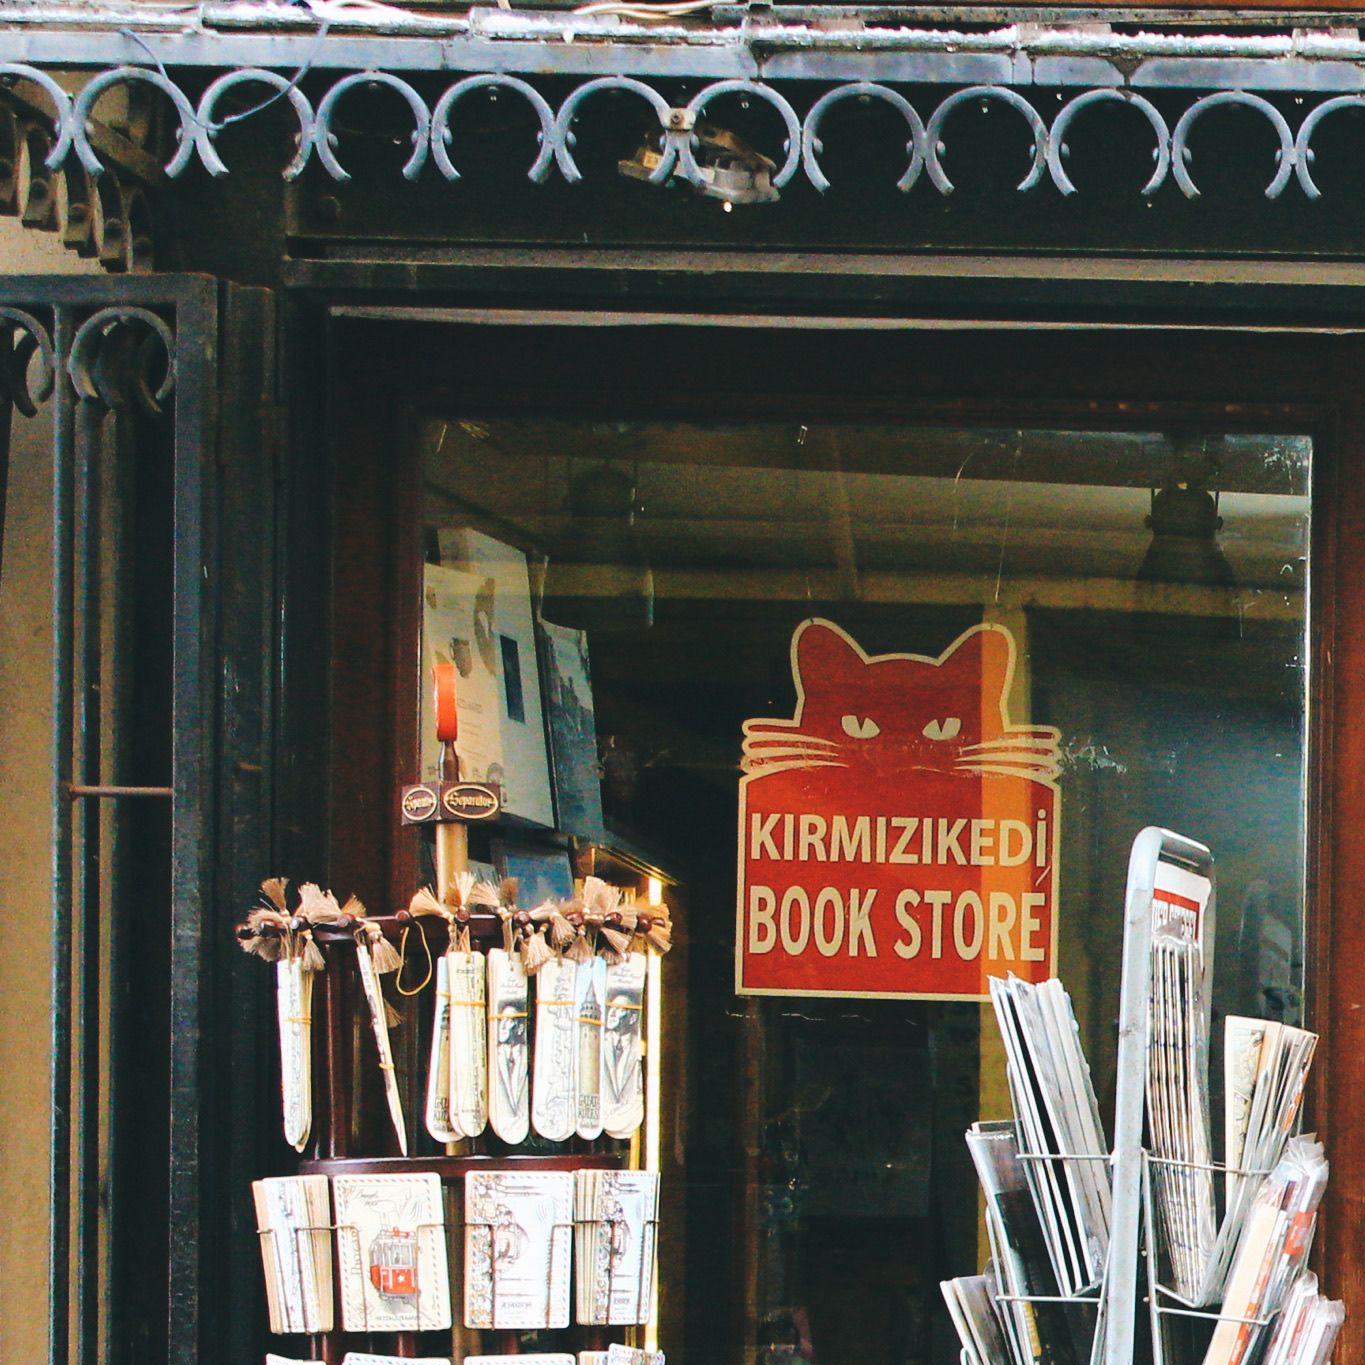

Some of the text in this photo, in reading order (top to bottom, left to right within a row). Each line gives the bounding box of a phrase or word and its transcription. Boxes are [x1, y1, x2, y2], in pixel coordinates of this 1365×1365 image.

[750, 809, 1047, 868] KIRMIZIKEDİ
[748, 886, 1046, 962] BOOK STORE
